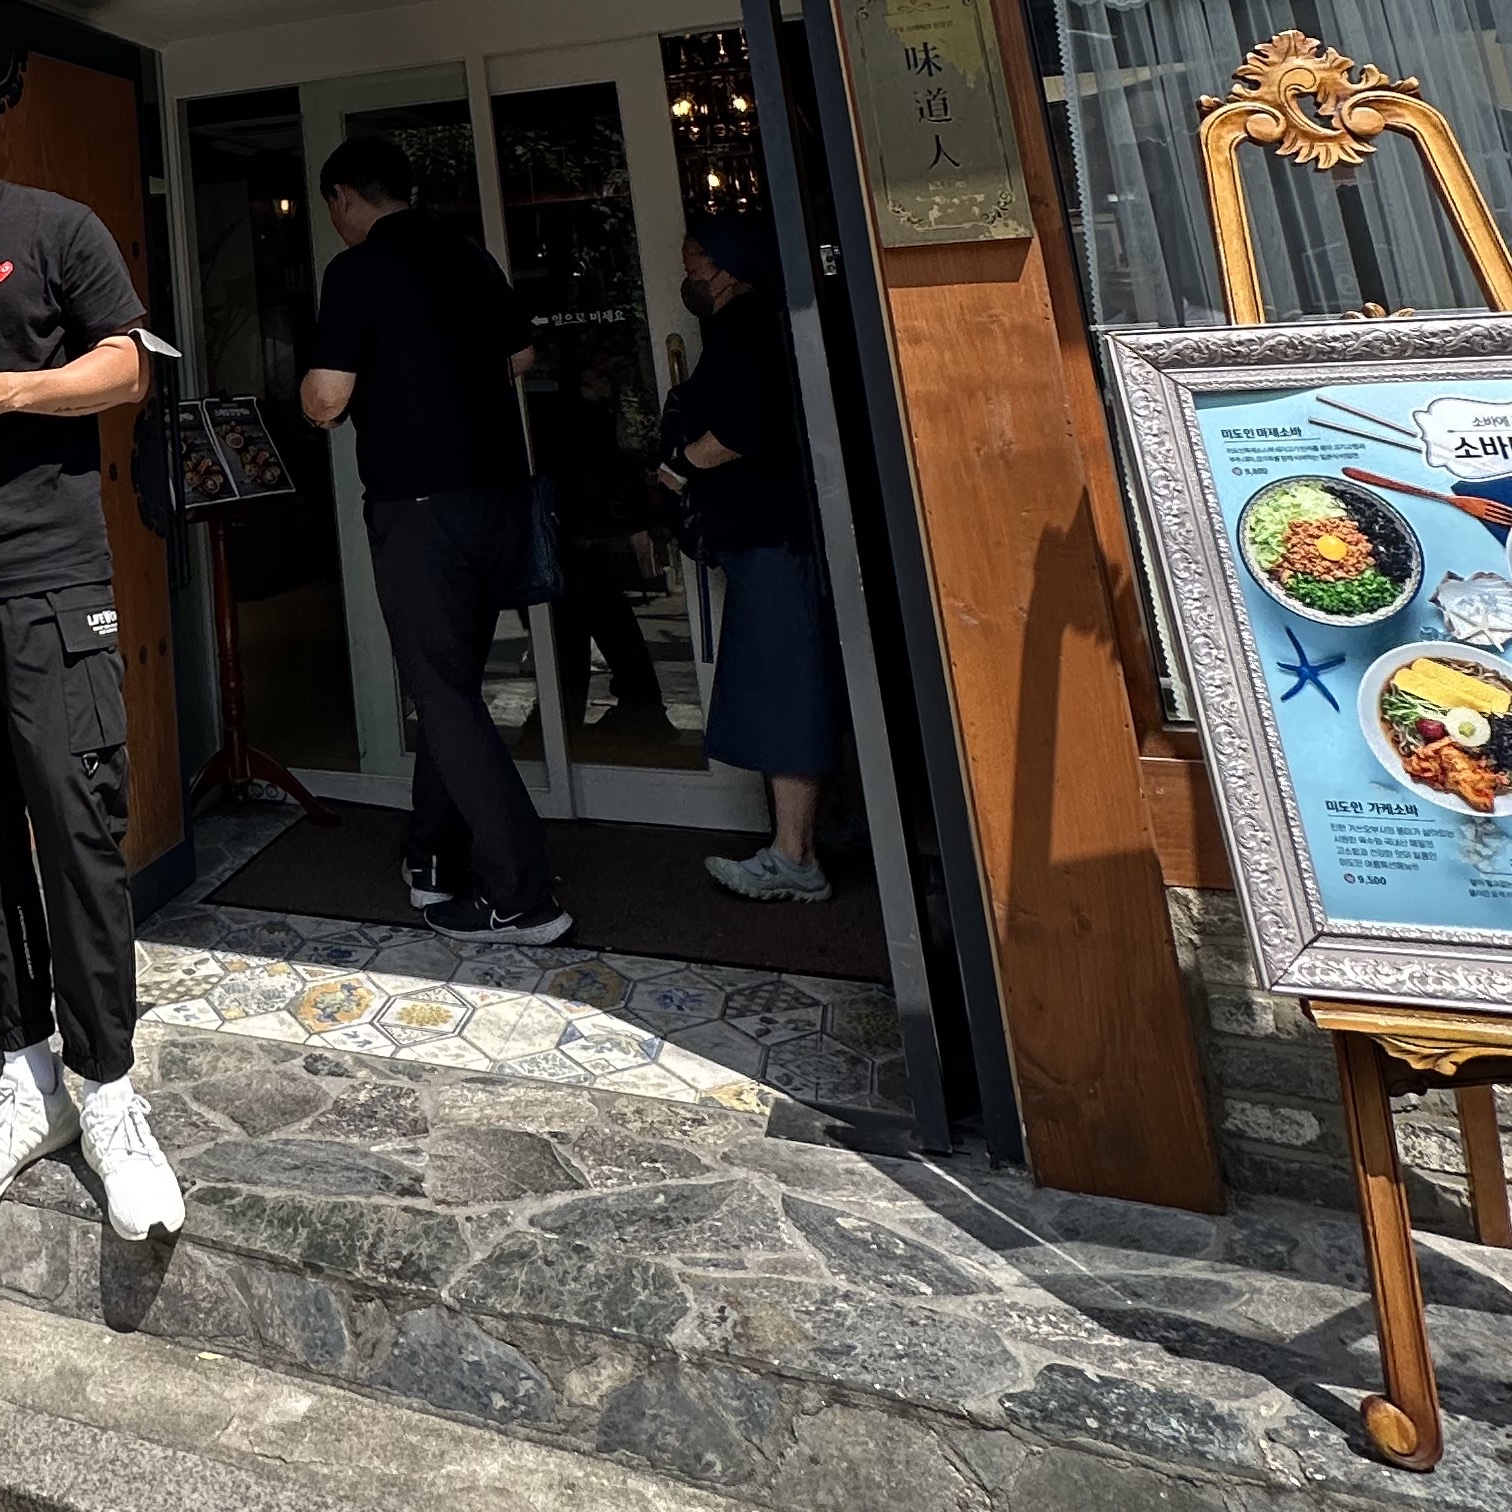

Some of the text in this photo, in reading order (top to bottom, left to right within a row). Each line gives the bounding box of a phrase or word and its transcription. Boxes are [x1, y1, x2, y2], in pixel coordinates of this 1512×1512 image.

[905, 42, 961, 172] 味道人
[589, 309, 626, 324] 미세요
[1455, 436, 1512, 460] 소바
[1325, 800, 1364, 814] 미도인
